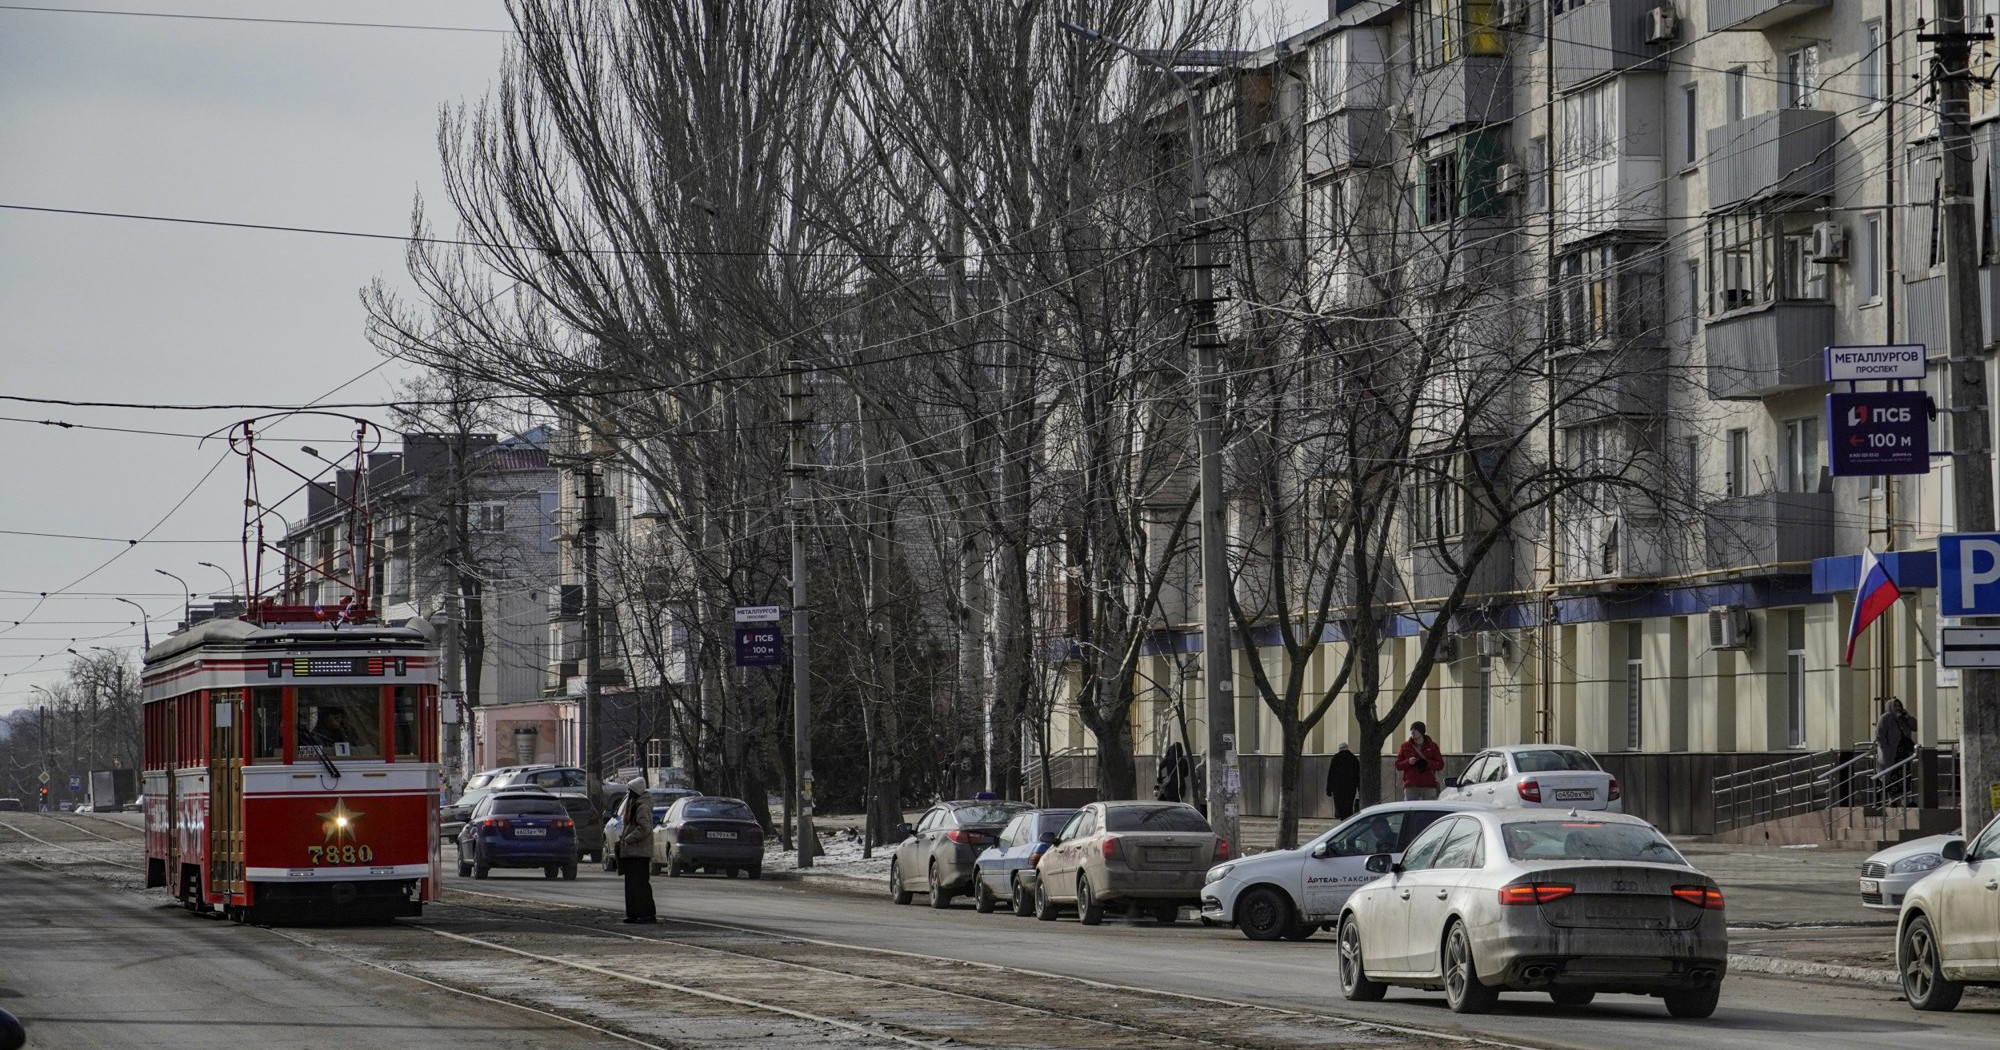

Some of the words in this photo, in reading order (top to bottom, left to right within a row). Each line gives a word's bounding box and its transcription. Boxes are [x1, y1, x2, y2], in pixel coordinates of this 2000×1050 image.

[1835, 352, 1919, 363] МЕТАЛЛУРГОВ
[1856, 365, 1898, 373] ПРОСПЕКТ
[1873, 407, 1911, 423] ПСБ
[1868, 433, 1896, 447] 100
[1960, 540, 2000, 609] P
[755, 634, 774, 642] ПСБ
[339, 744, 346, 754] 1
[308, 844, 373, 865] 7880
